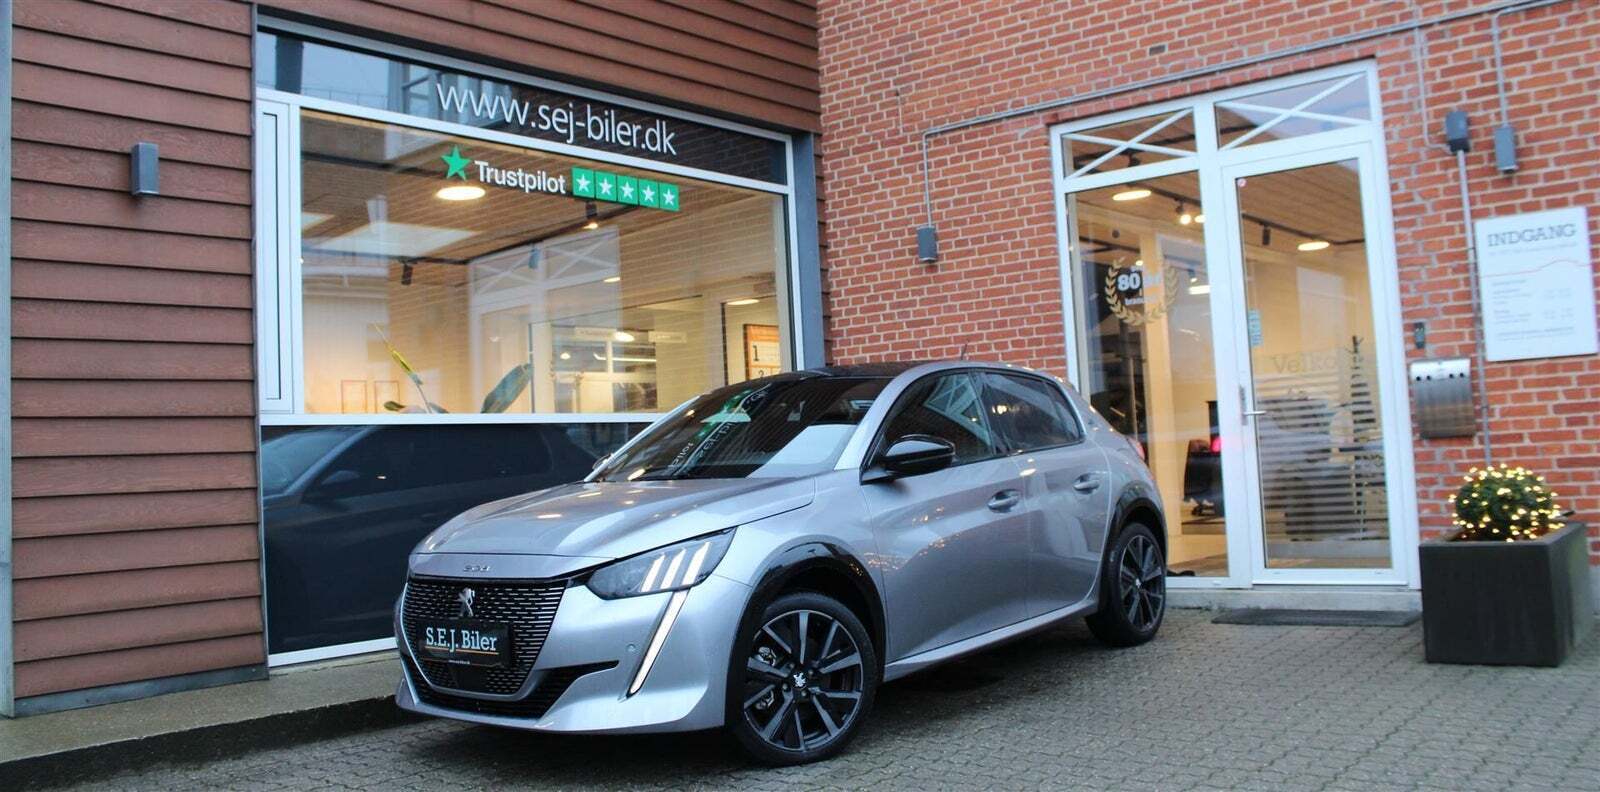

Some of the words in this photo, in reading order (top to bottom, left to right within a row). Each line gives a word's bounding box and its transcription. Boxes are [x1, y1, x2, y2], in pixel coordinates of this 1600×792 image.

[437, 83, 677, 156] www.sej-biler.dk
[474, 160, 566, 195] Trustpilot
[1487, 223, 1577, 247] INDGANG
[1117, 272, 1141, 291] 80
[425, 627, 459, 653] S.E.J.
[461, 629, 498, 652] Biler
